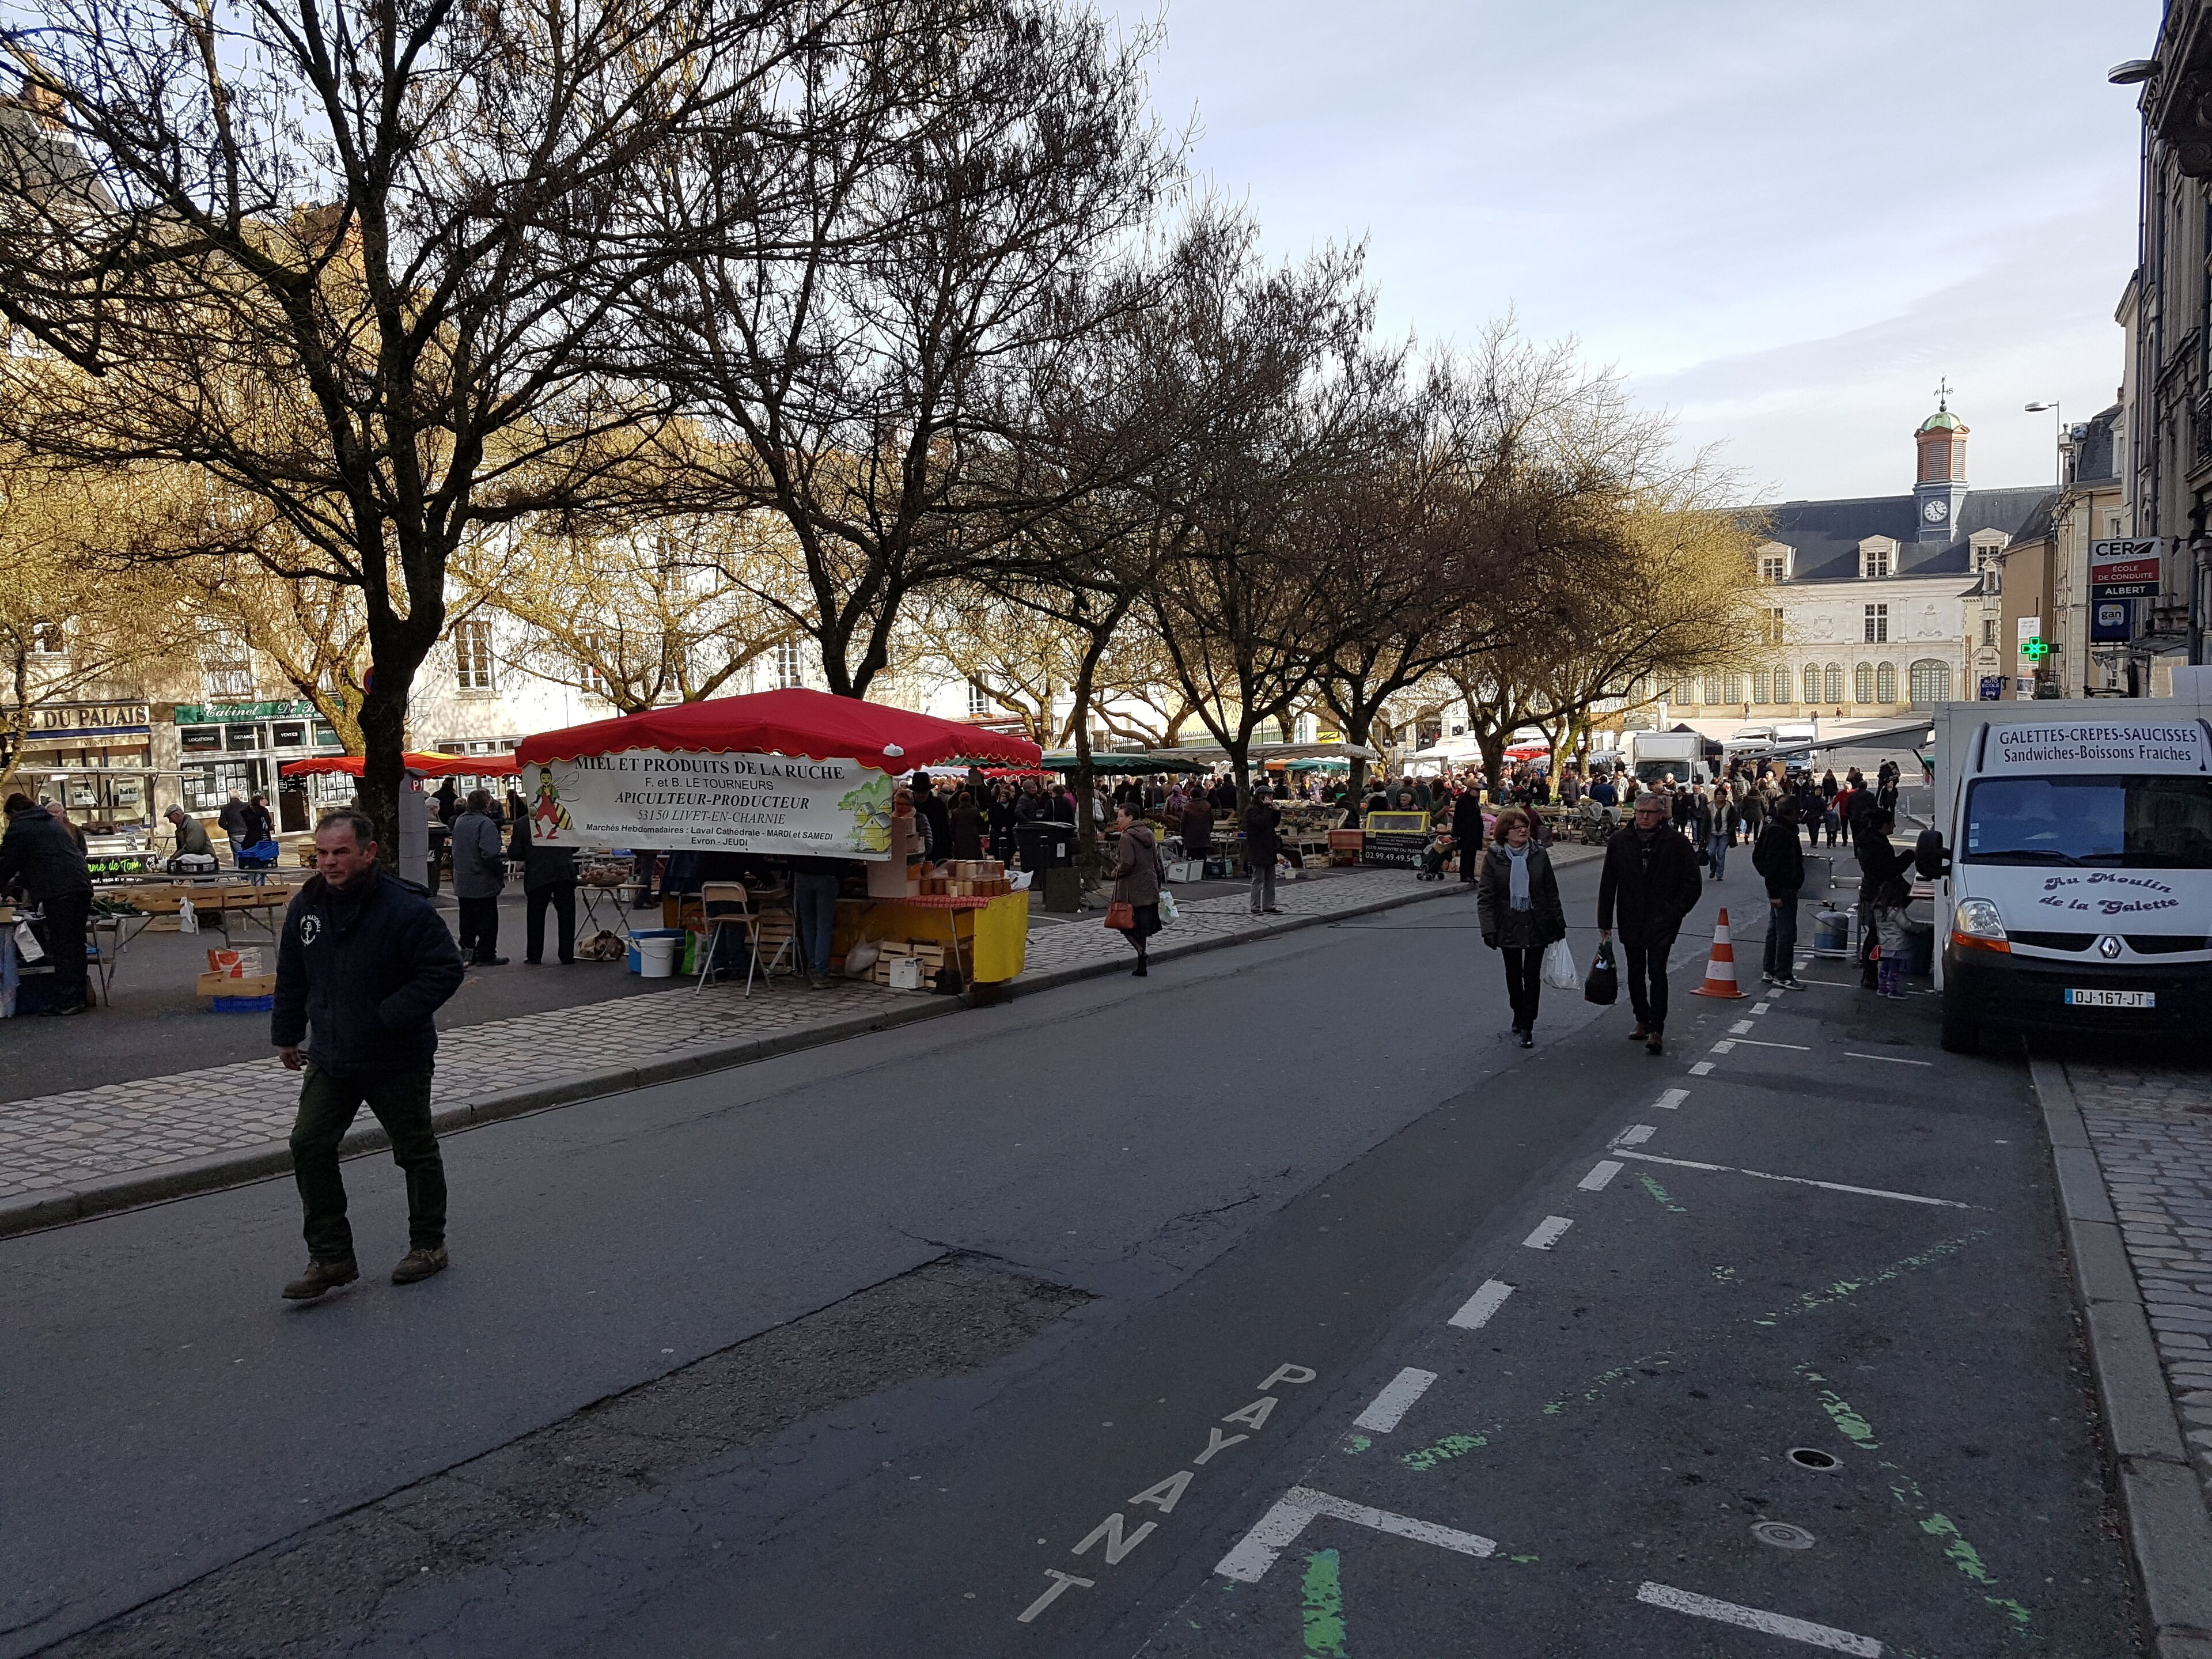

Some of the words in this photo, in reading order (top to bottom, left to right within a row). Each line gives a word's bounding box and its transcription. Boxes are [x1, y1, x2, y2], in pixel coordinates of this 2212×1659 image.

[2096, 542, 2135, 556] CER
[2111, 572, 2153, 580] CONDUITE
[2105, 586, 2146, 595] ALBERT
[2101, 611, 2122, 620] gan
[43, 710, 70, 728] DU
[78, 706, 146, 728] PALAIS
[1999, 728, 2197, 744] GALETTES-CREPES-SAUCISSES
[2004, 745, 2135, 762] Sandwiches-Boissons
[575, 756, 615, 770] MIEL
[619, 757, 639, 771] ET
[644, 759, 729, 774] PRODUITS
[734, 761, 756, 774] DE
[760, 763, 782, 777] LA
[785, 764, 844, 779] RUCHE
[413, 780, 419, 791] P
[645, 778, 654, 787] F.
[658, 778, 668, 787] et
[672, 778, 683, 787] B.
[686, 778, 700, 787] LE
[703, 778, 774, 790] TOURNEURS
[615, 791, 809, 809] APICULTEUR-PRODUCTEUR
[638, 810, 669, 820] 53150
[672, 810, 786, 824] LIVET-EN-CHARNIE
[622, 825, 683, 834] Hebdomadaires
[716, 827, 760, 836] Cathédrale
[767, 830, 791, 838] MARDI
[802, 832, 833, 840] SAMEDI
[691, 837, 715, 845] Evron
[723, 838, 748, 847] JEUDI
[108, 859, 120, 871] de
[2043, 876, 2080, 891] Au
[2086, 873, 2172, 893] Moulin
[2039, 896, 2064, 907] de
[2067, 899, 2089, 910] la
[2097, 899, 2179, 915] Galette
[2076, 991, 2143, 1006] DJ-167-JT
[1017, 1363, 1316, 1622] PAYANT
